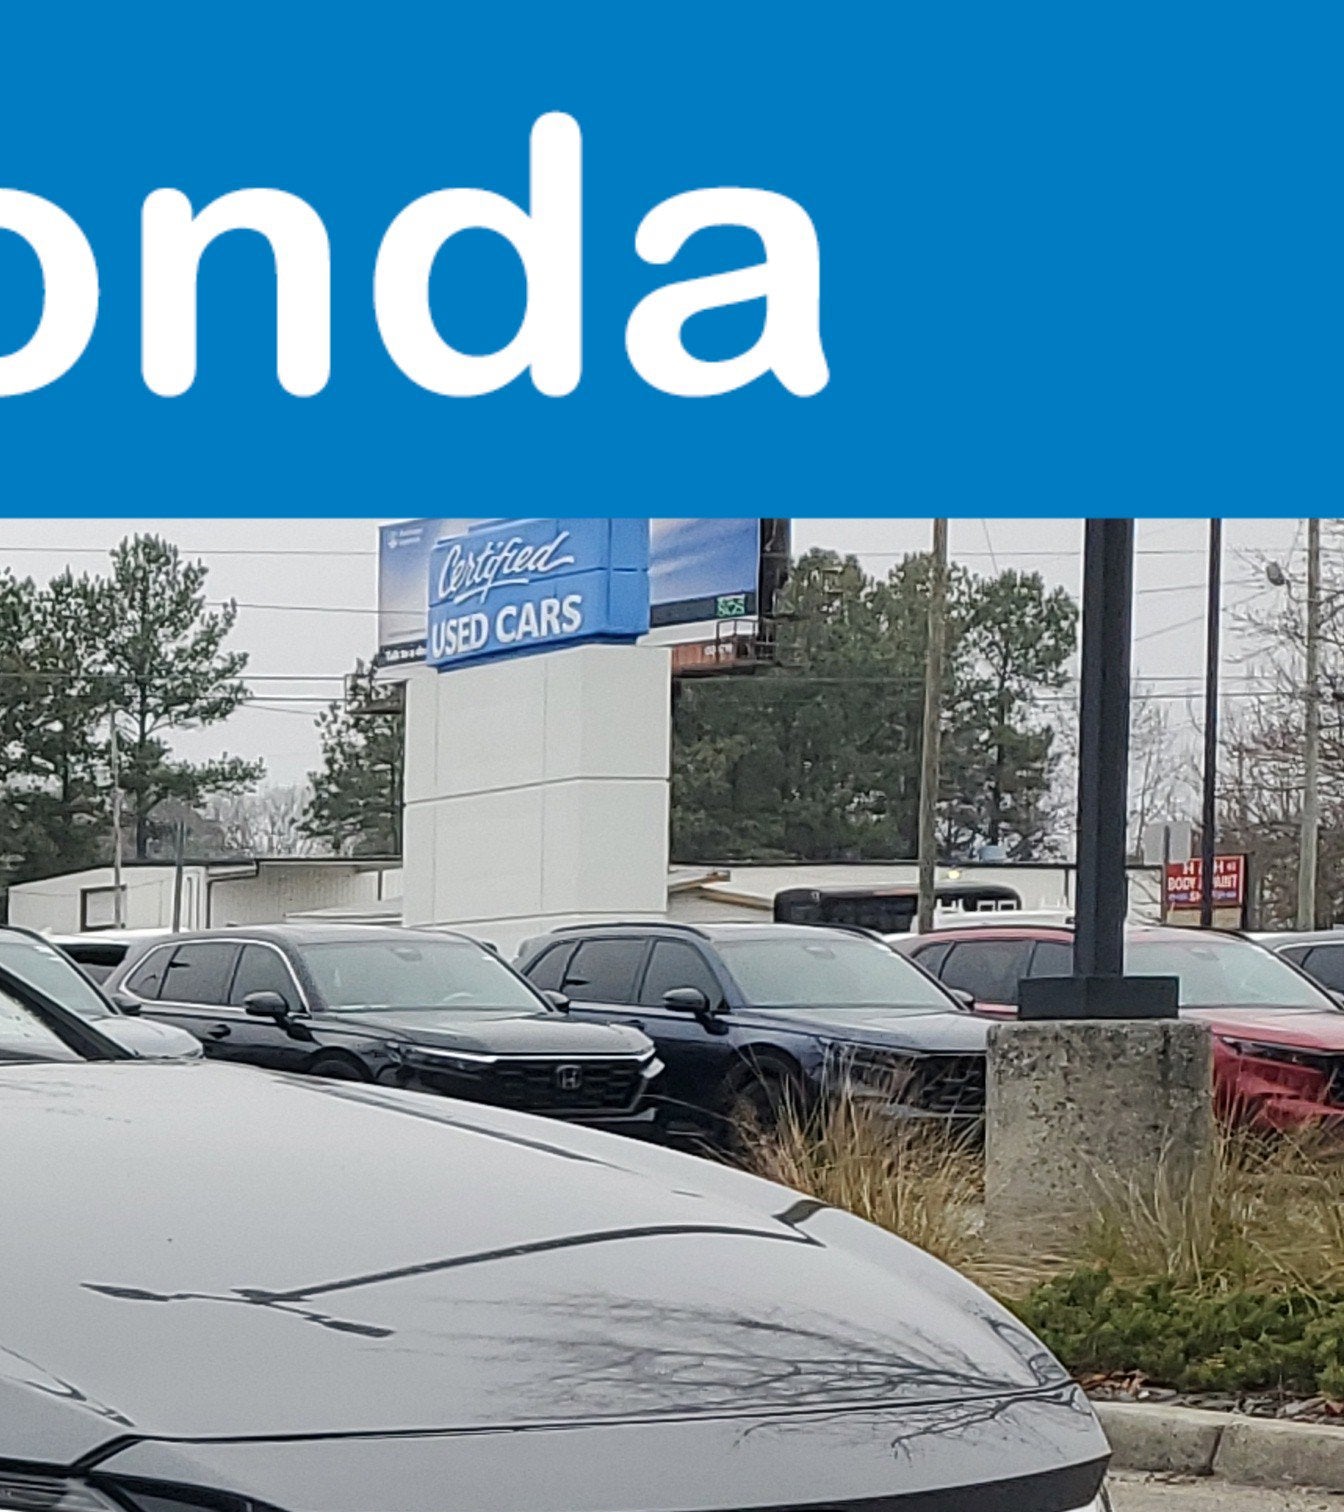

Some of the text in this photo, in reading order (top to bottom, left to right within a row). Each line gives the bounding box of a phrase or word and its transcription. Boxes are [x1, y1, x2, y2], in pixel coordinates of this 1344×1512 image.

[439, 531, 574, 604] Certified
[432, 594, 582, 659] USED CARS
[1168, 876, 1197, 891] BODY
